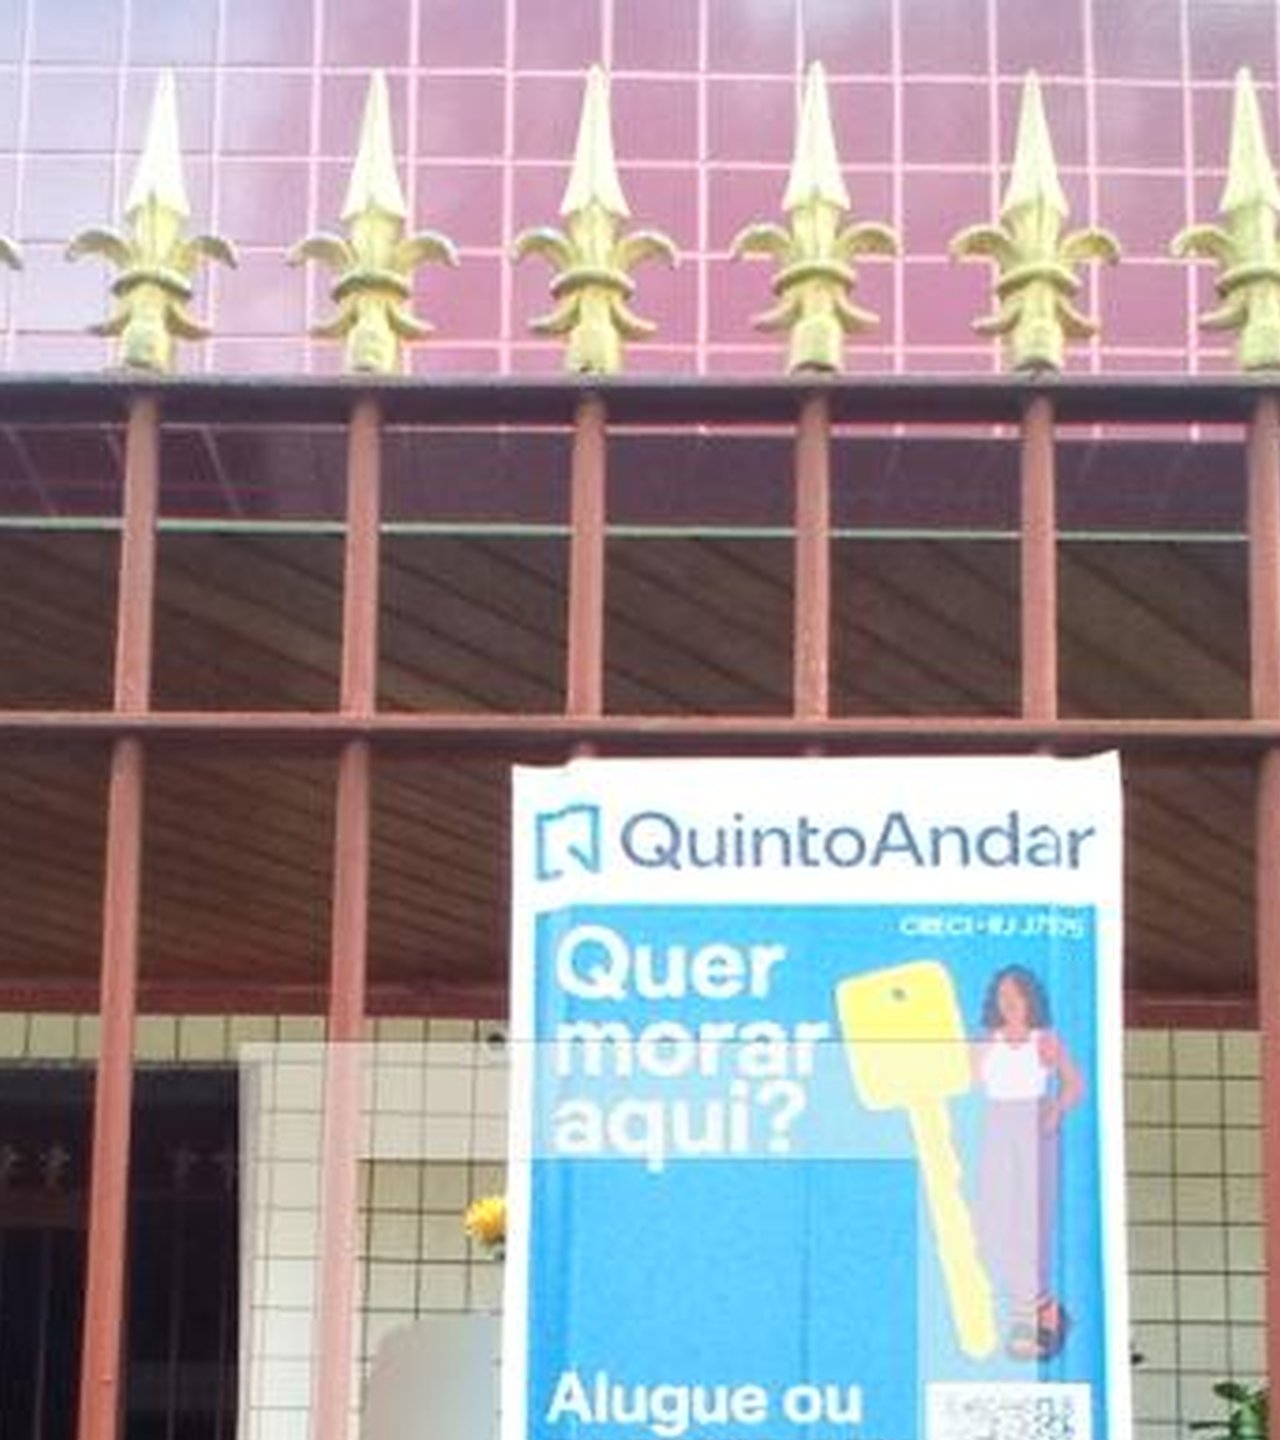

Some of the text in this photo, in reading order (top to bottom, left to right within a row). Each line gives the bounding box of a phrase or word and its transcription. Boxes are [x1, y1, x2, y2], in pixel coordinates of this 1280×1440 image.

[621, 811, 1095, 871] QuintoAndar
[556, 925, 786, 999] Quer
[554, 1016, 830, 1077] morar
[552, 1081, 806, 1171] aqui?
[546, 1369, 863, 1435] Alugue ou
